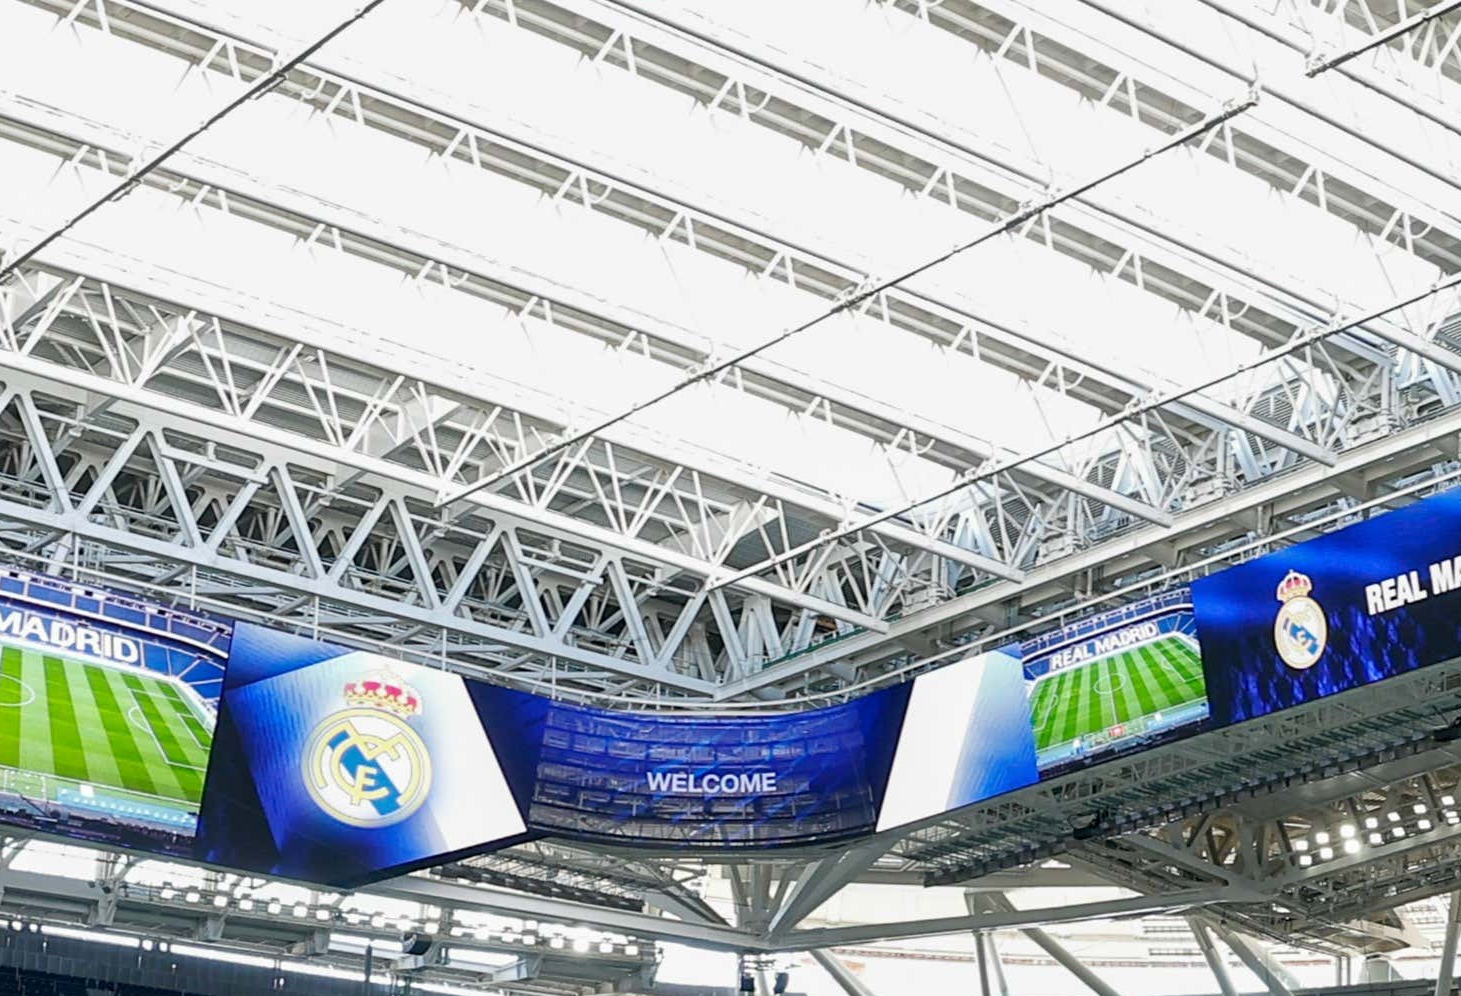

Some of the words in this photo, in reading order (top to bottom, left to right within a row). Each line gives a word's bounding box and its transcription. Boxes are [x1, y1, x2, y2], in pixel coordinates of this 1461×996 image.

[1365, 576, 1426, 615] REAL
[1050, 644, 1092, 669] REAL
[1096, 624, 1157, 660] MADRID
[647, 771, 777, 794] WELCOME
